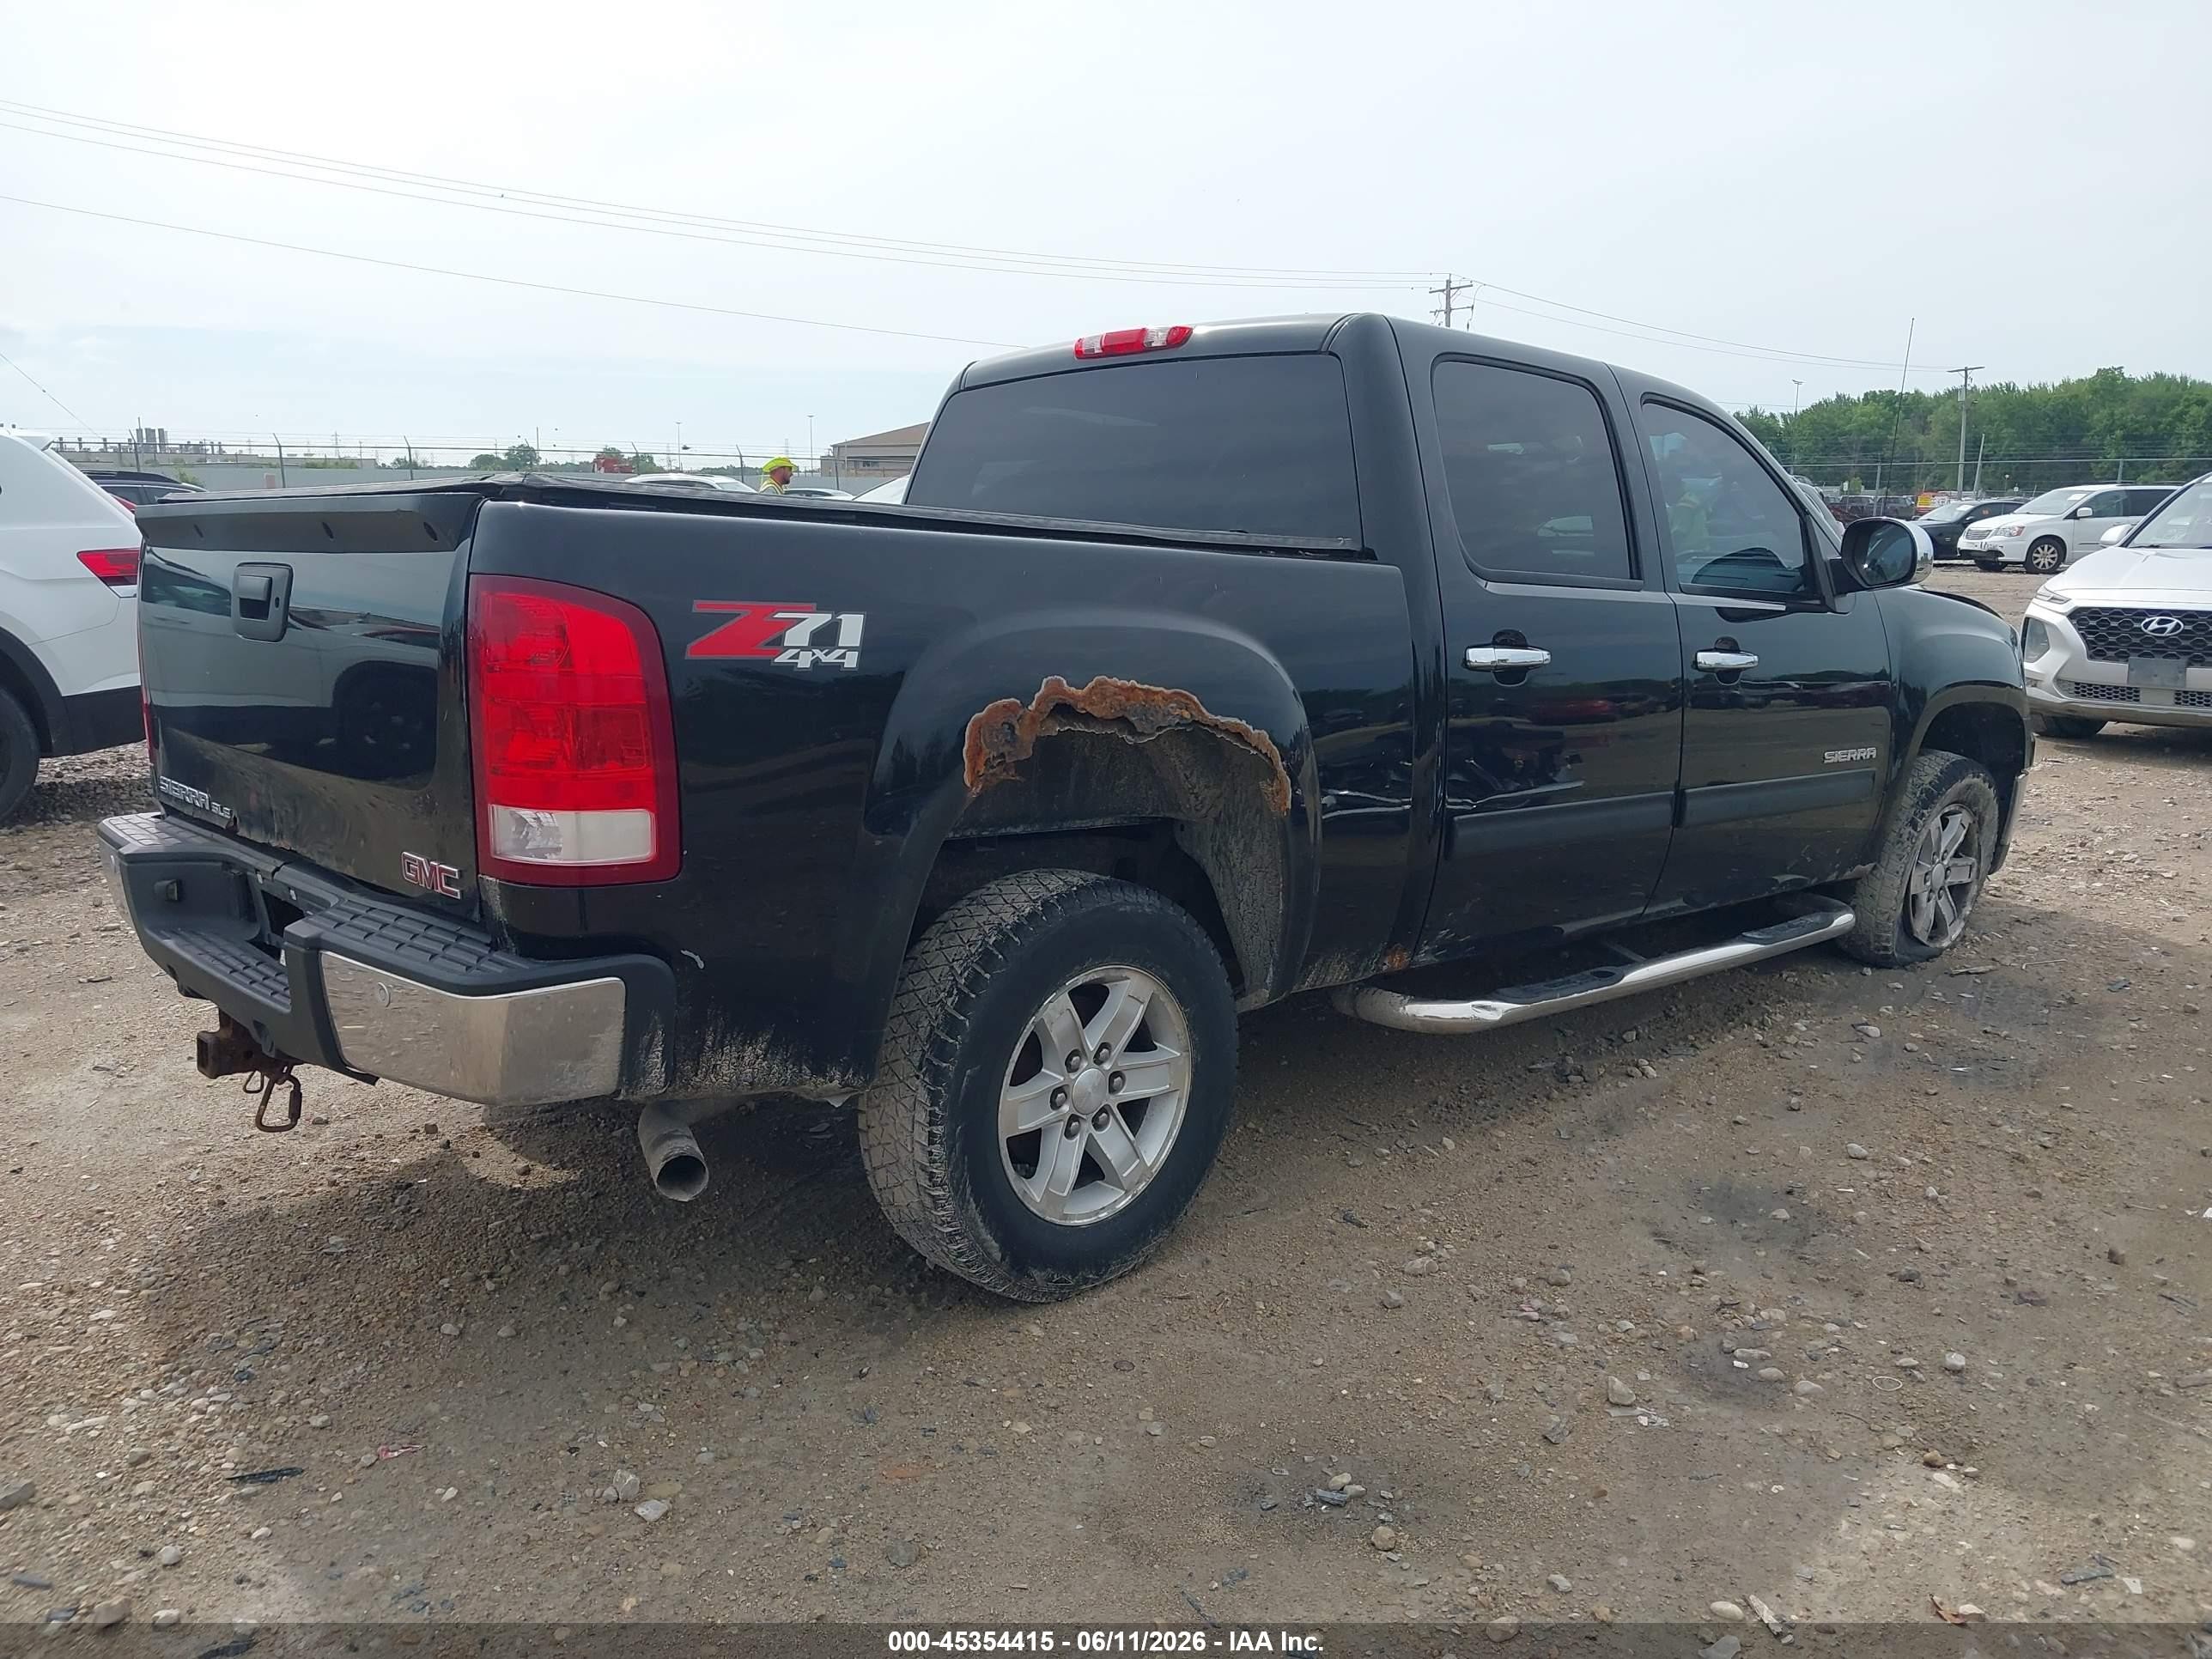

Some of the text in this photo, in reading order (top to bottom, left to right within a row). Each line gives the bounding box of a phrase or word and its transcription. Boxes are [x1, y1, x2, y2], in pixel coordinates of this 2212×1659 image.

[1824, 747, 1877, 763] SIERRA
[159, 775, 232, 819] SIERRA SLE
[401, 851, 461, 900] GMC
